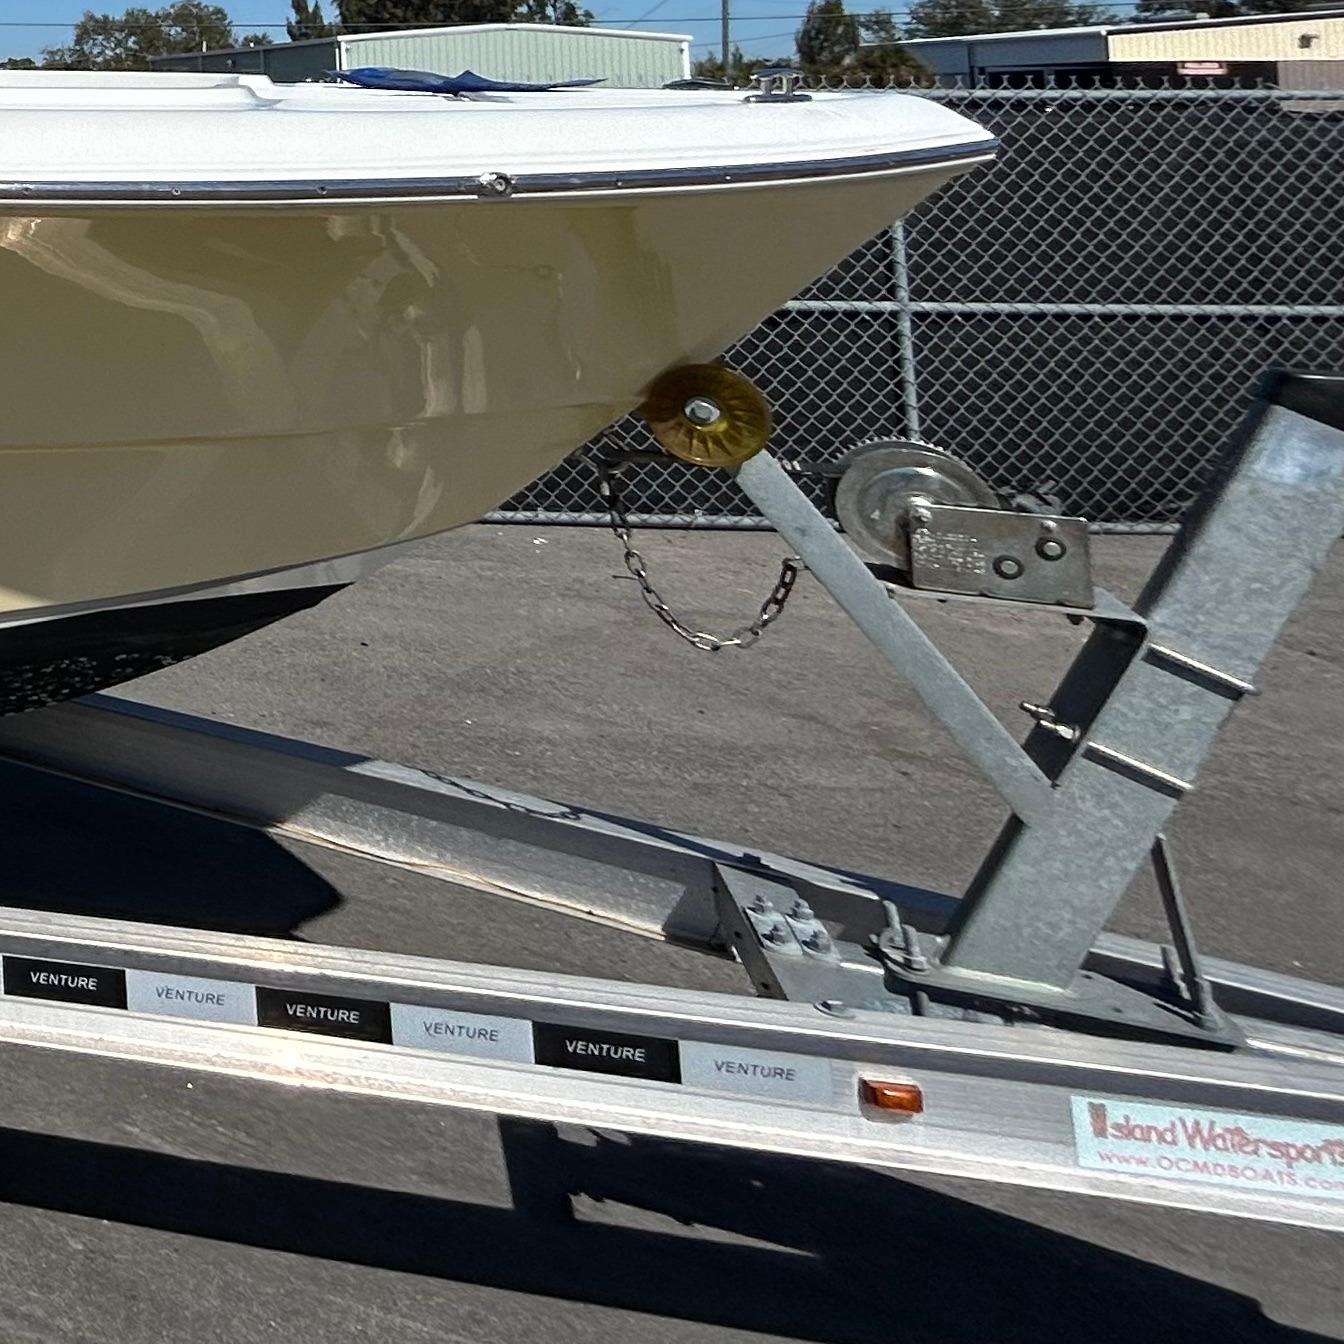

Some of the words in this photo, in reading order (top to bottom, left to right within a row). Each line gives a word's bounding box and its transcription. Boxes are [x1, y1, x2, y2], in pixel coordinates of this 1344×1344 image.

[28, 971, 100, 992] VENTURE
[154, 985, 227, 1007] VENTURE
[284, 1002, 362, 1025] VENTURE
[422, 1019, 500, 1043] VENTURE
[564, 1038, 648, 1062] VENTURE
[713, 1058, 798, 1083] VENTURE
